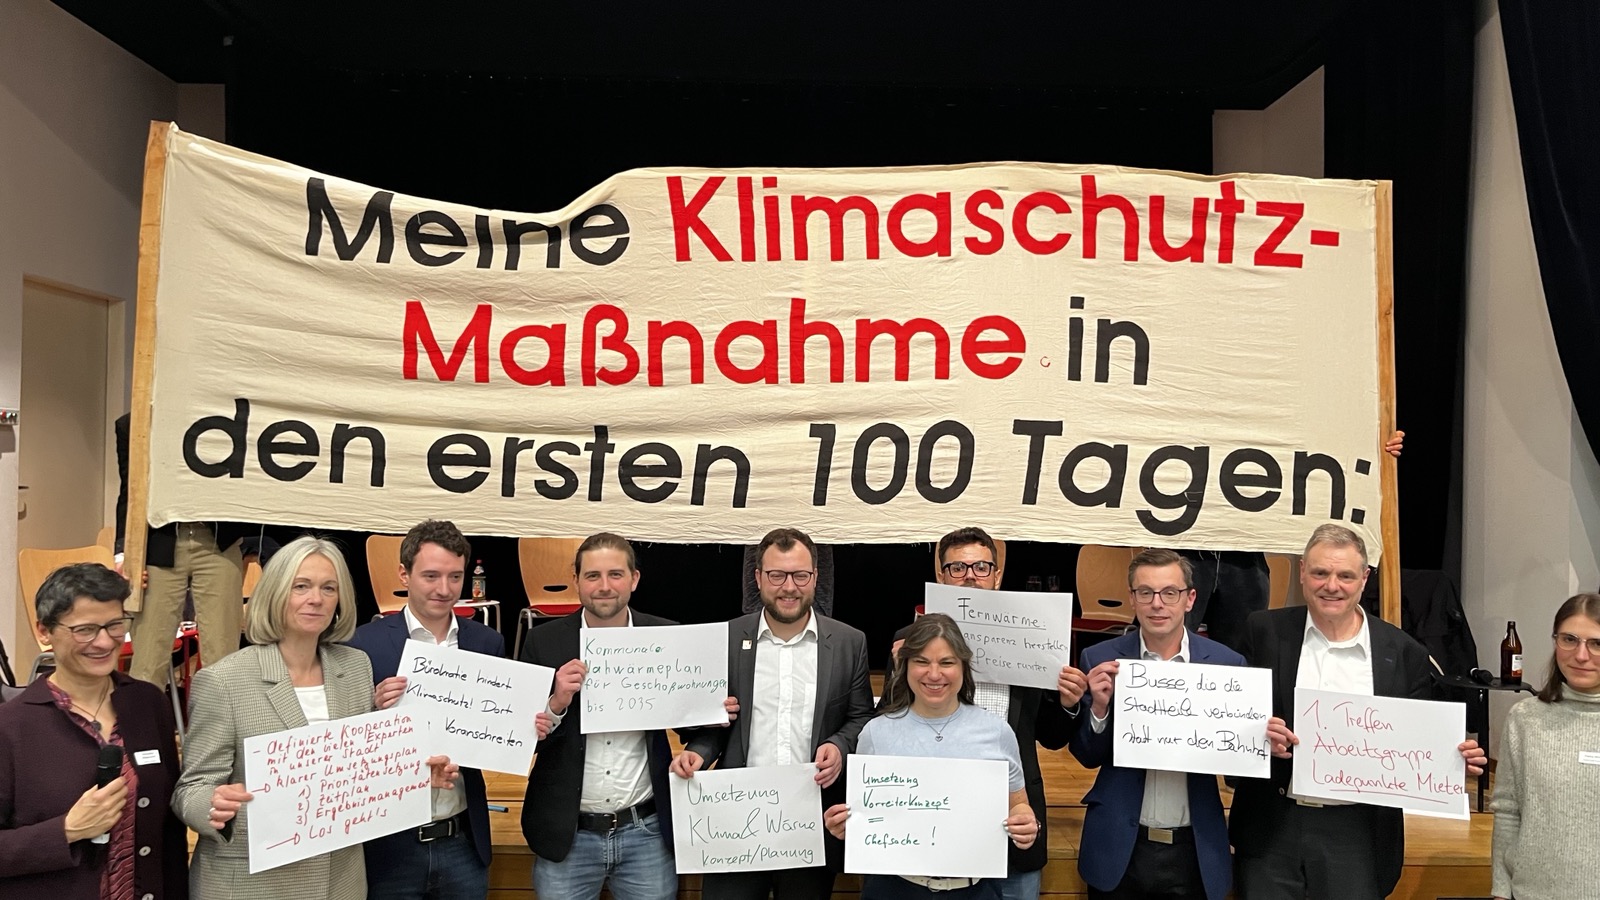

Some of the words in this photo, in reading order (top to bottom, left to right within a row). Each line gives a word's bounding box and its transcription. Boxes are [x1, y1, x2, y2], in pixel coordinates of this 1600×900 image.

[305, 177, 630, 270] Meine
[667, 175, 1340, 268] Klimaschutz-
[403, 298, 1026, 387] Maßnahme
[1068, 297, 1150, 386] in
[183, 398, 386, 487] den
[427, 425, 751, 508] ersten
[809, 420, 975, 506] 100
[1013, 419, 1371, 536] Tagen:
[957, 597, 1046, 627] Fernwärme:
[964, 632, 1016, 645] ansparenz
[412, 656, 468, 682] Bürokratie
[476, 669, 512, 690] hindert
[584, 658, 702, 679] Nahwärmeplan
[976, 647, 1012, 669] Preise
[1017, 661, 1047, 672] runter
[584, 677, 611, 691] für
[621, 677, 727, 695] Geschoßwohnungen
[1126, 662, 1190, 693] Busse,
[1196, 673, 1217, 691] die
[1224, 678, 1243, 692] die
[406, 681, 474, 710] Klimaschutz!
[481, 699, 513, 715] Dort
[587, 698, 604, 713] bis
[616, 697, 656, 711] 2035
[1123, 697, 1199, 717] Stadtteile
[1204, 702, 1267, 720] verbinden
[340, 713, 411, 740] Kooperation
[1303, 699, 1328, 730] 1.
[1333, 701, 1394, 734] Treffen
[267, 752, 288, 765] mit
[296, 747, 315, 759] den
[324, 738, 355, 753] vielen
[367, 726, 413, 745] Experten
[445, 717, 523, 747] Voranschreiten
[1122, 724, 1152, 745] statt
[1157, 736, 1182, 745] nur
[1187, 729, 1214, 750] den
[1216, 730, 1271, 760] Bahnhof
[270, 767, 279, 775] in
[290, 755, 333, 770] unserer
[342, 743, 379, 759] Stadt
[324, 747, 417, 776] Umsetzungsplan
[1313, 731, 1434, 771] Arbeitsgruppe
[863, 762, 919, 789] Umsetzung
[1312, 759, 1409, 793] Ladepunkte
[1417, 772, 1463, 795] Mieter
[296, 812, 308, 826] 3)
[316, 777, 431, 821] Ergebnismanagement
[297, 799, 310, 812] 2)
[298, 784, 311, 799] 1)
[687, 781, 780, 806] Umsetzung
